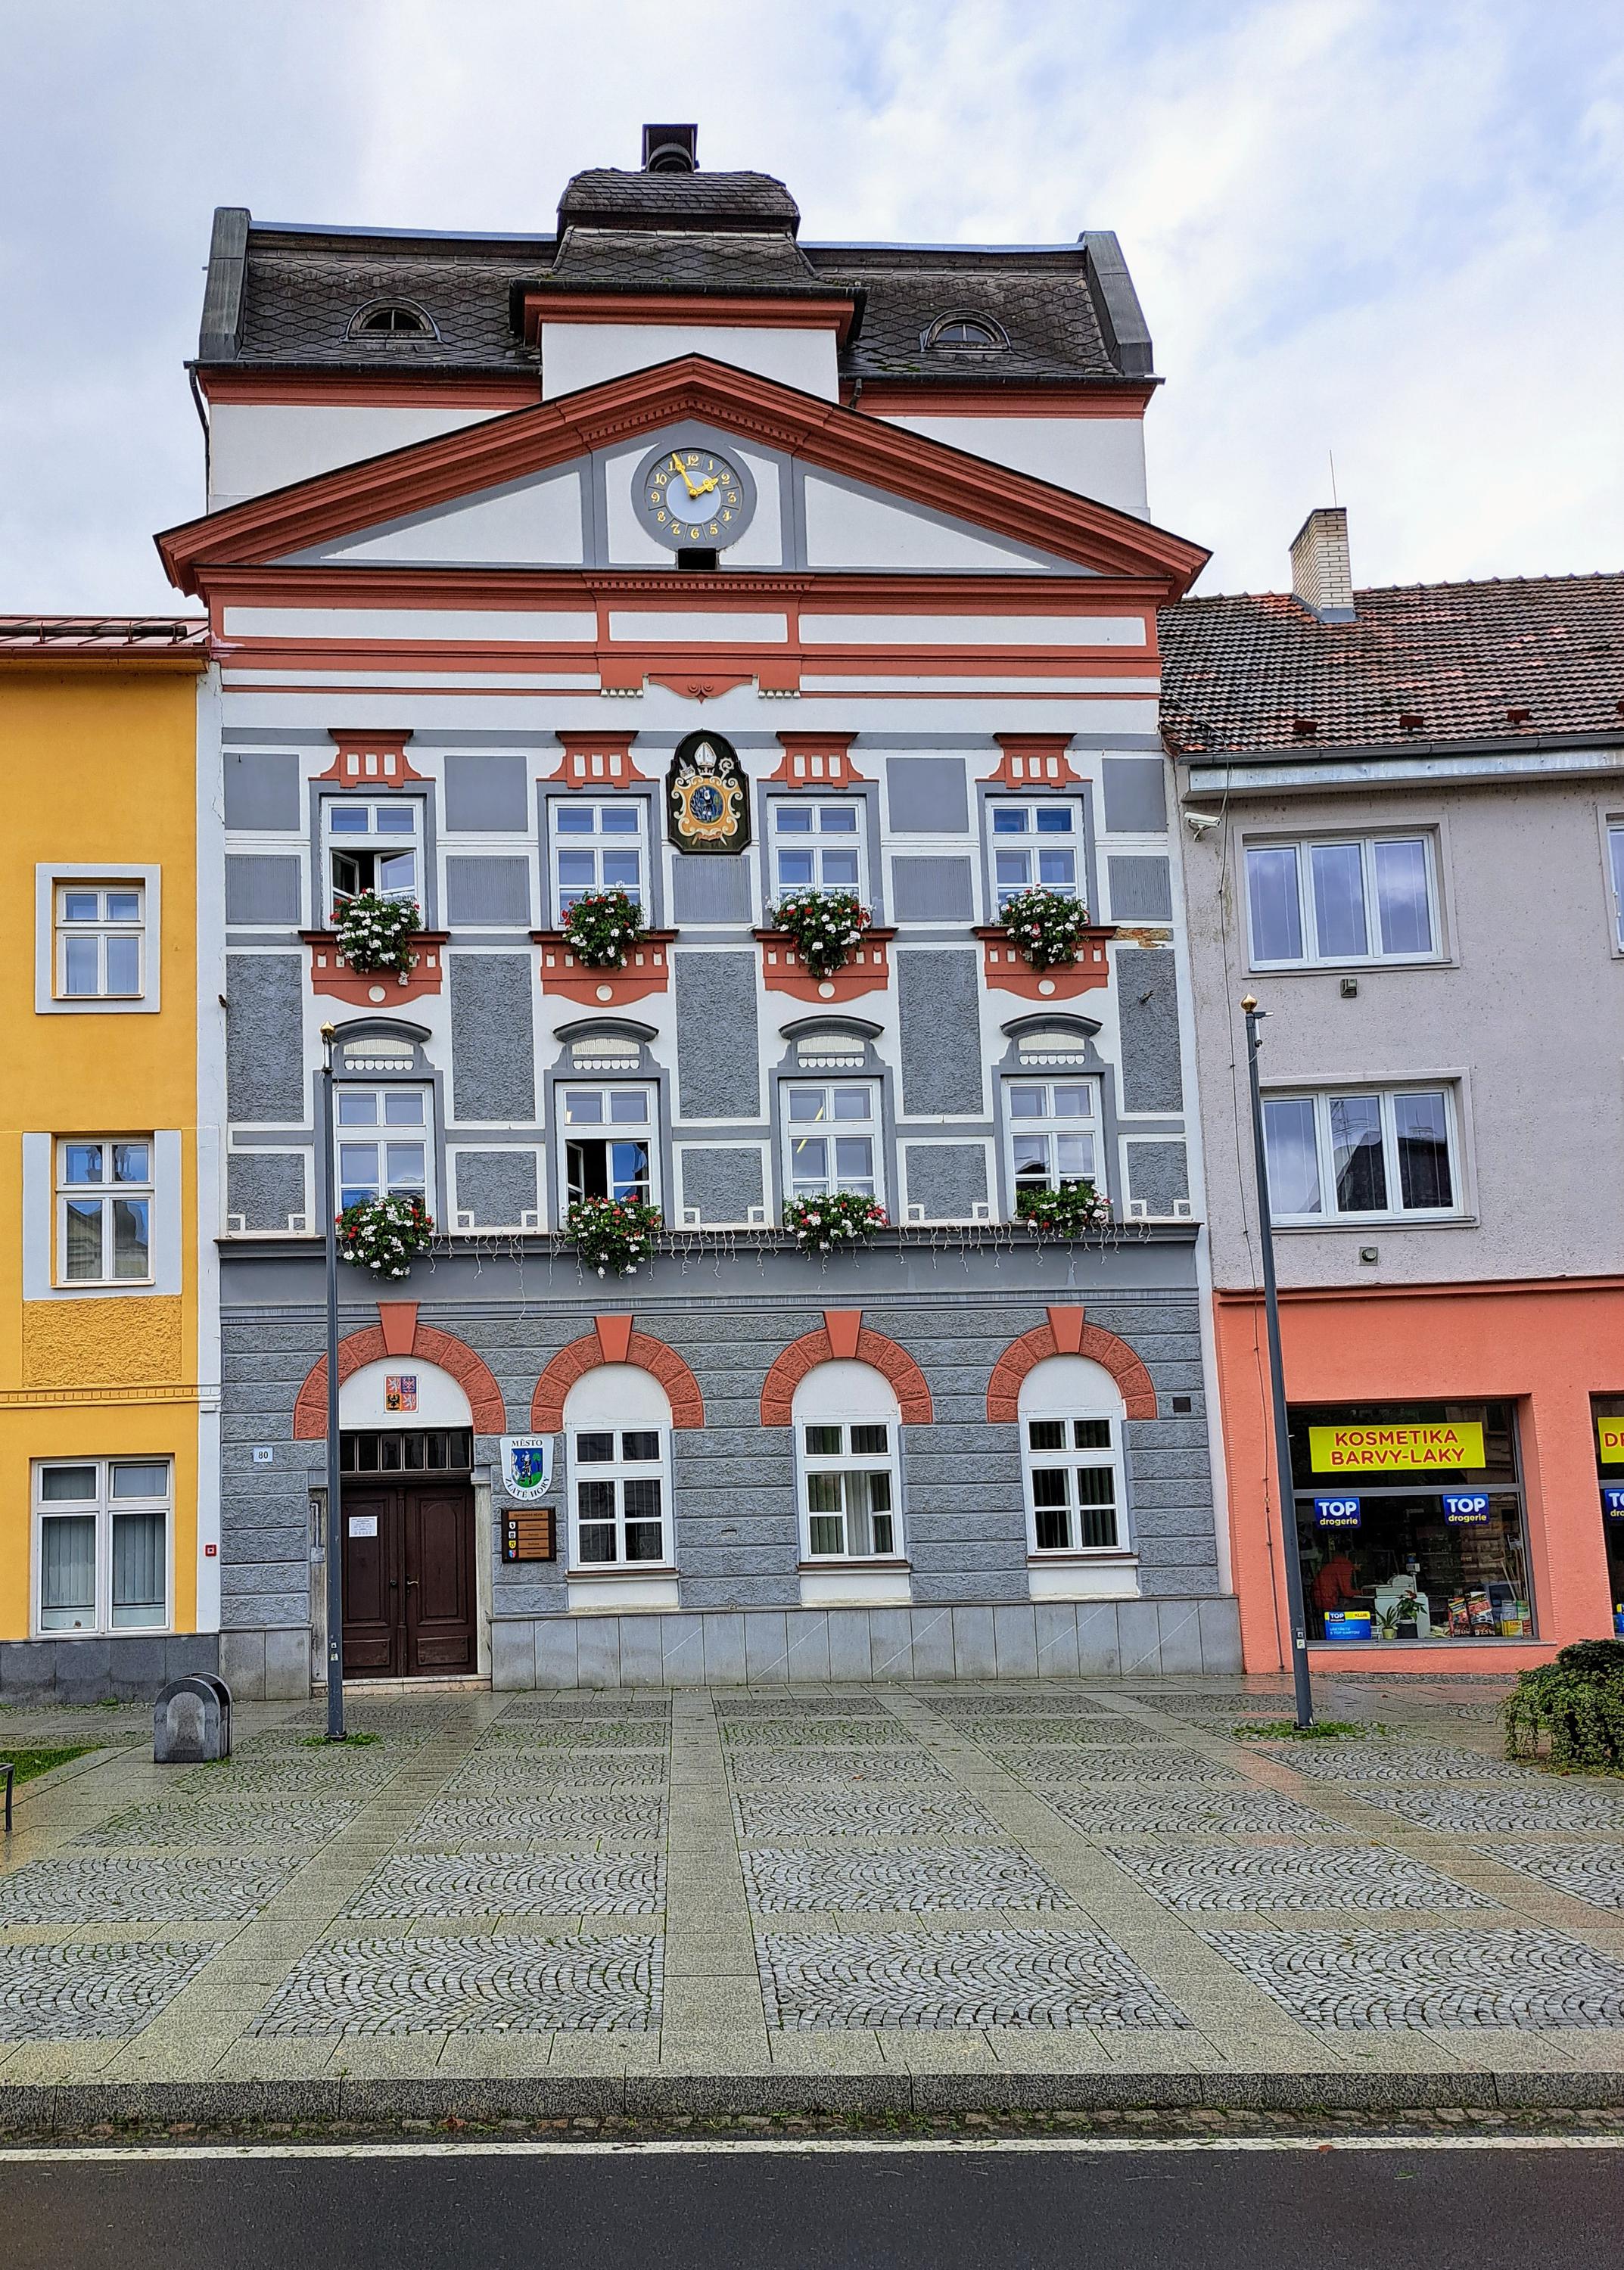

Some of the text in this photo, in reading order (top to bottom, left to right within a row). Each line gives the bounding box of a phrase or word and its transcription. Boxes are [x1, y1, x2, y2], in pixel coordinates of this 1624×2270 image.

[686, 455, 699, 466] 12
[708, 459, 714, 471] 1
[655, 473, 667, 485] 10
[721, 473, 730, 484] 2
[651, 491, 660, 502] 9
[727, 492, 736, 503] 3
[658, 511, 666, 522] 8
[723, 509, 732, 521] 4
[671, 523, 680, 534] 7
[690, 527, 700, 540] 6
[710, 524, 718, 535] 5
[512, 1438, 543, 1448] MĚSTO
[1335, 1429, 1458, 1447] KOSMETIKA
[1331, 1448, 1465, 1466] BARVY-LAKY
[530, 1476, 549, 1497] HORY
[1318, 1501, 1357, 1516] TOP
[1447, 1498, 1486, 1513] TOP
[1320, 1516, 1358, 1526] drogerie
[1448, 1513, 1487, 1522] drogerie
